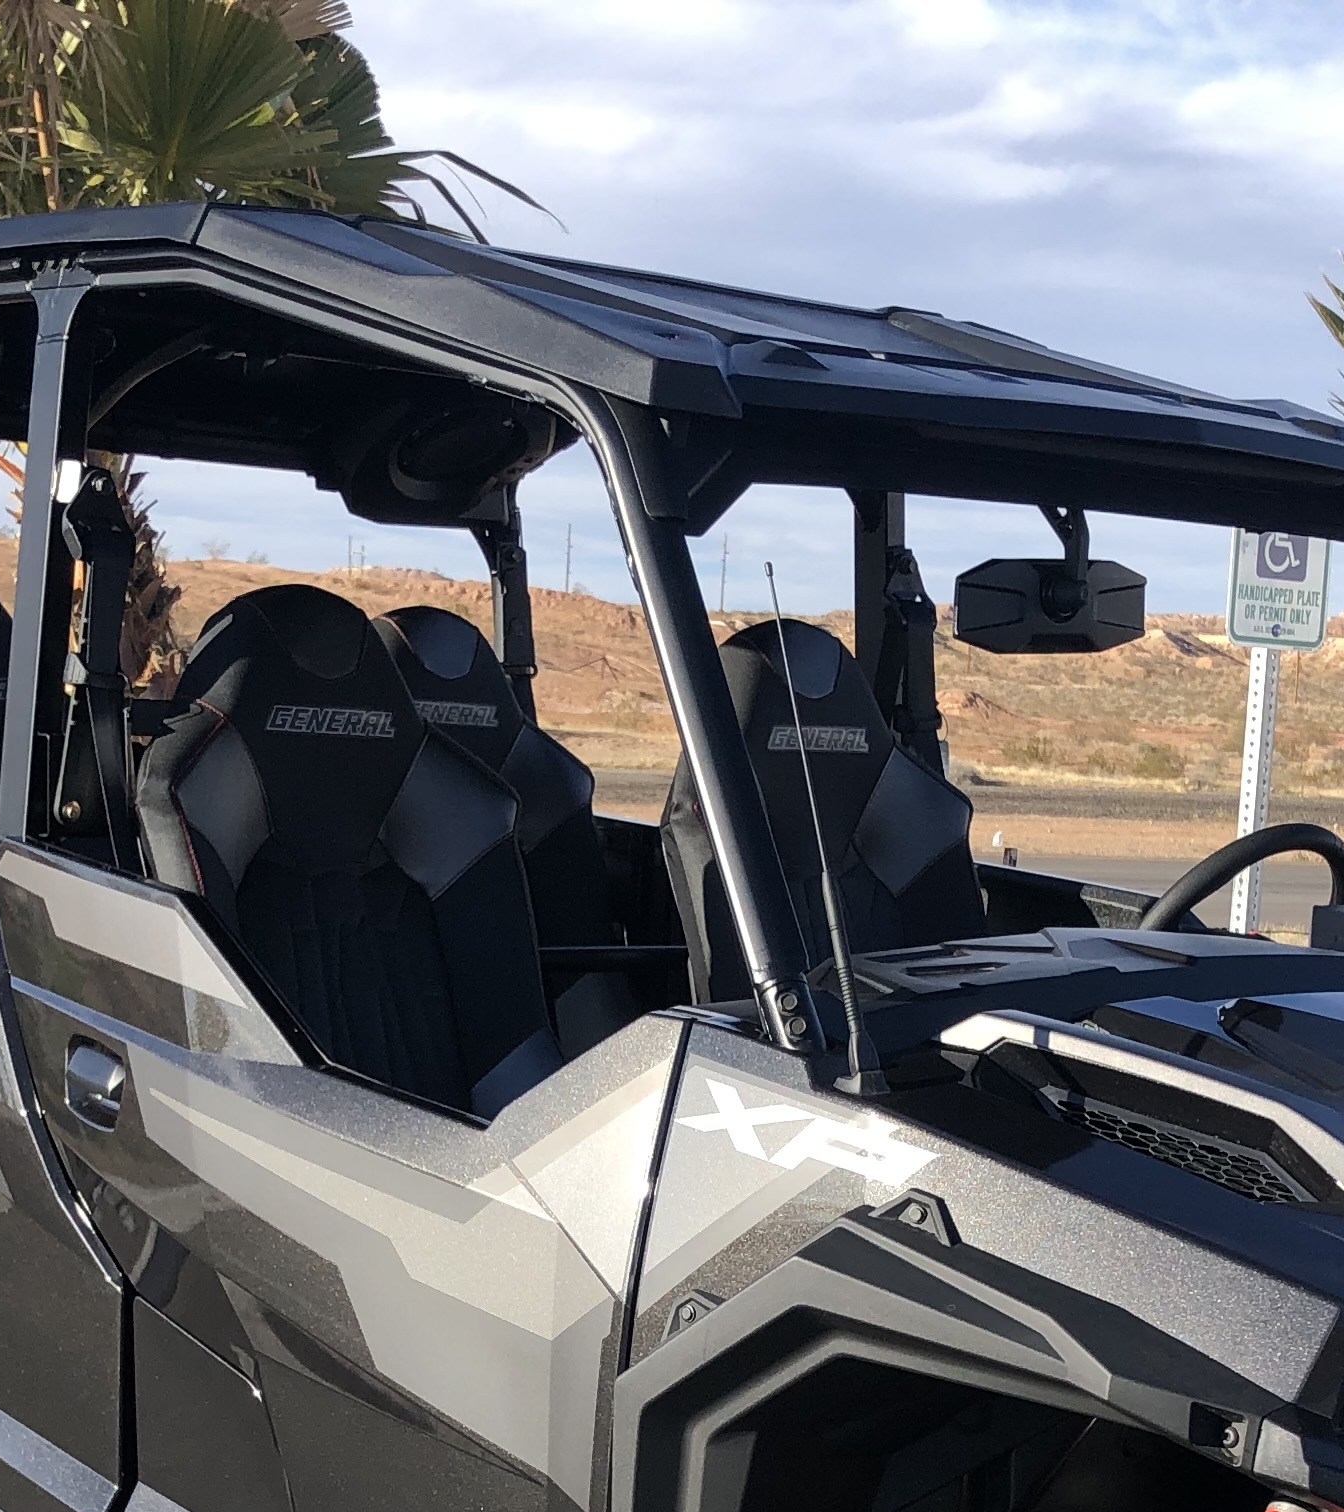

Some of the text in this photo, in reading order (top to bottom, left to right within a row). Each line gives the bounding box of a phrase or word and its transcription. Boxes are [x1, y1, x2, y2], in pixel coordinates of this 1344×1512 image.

[1238, 584, 1321, 607] HANDICAPPED PLATE
[1245, 604, 1311, 625] OR PERMIT ONLY
[266, 705, 395, 738] GENERAL
[767, 726, 870, 753] GENERAL
